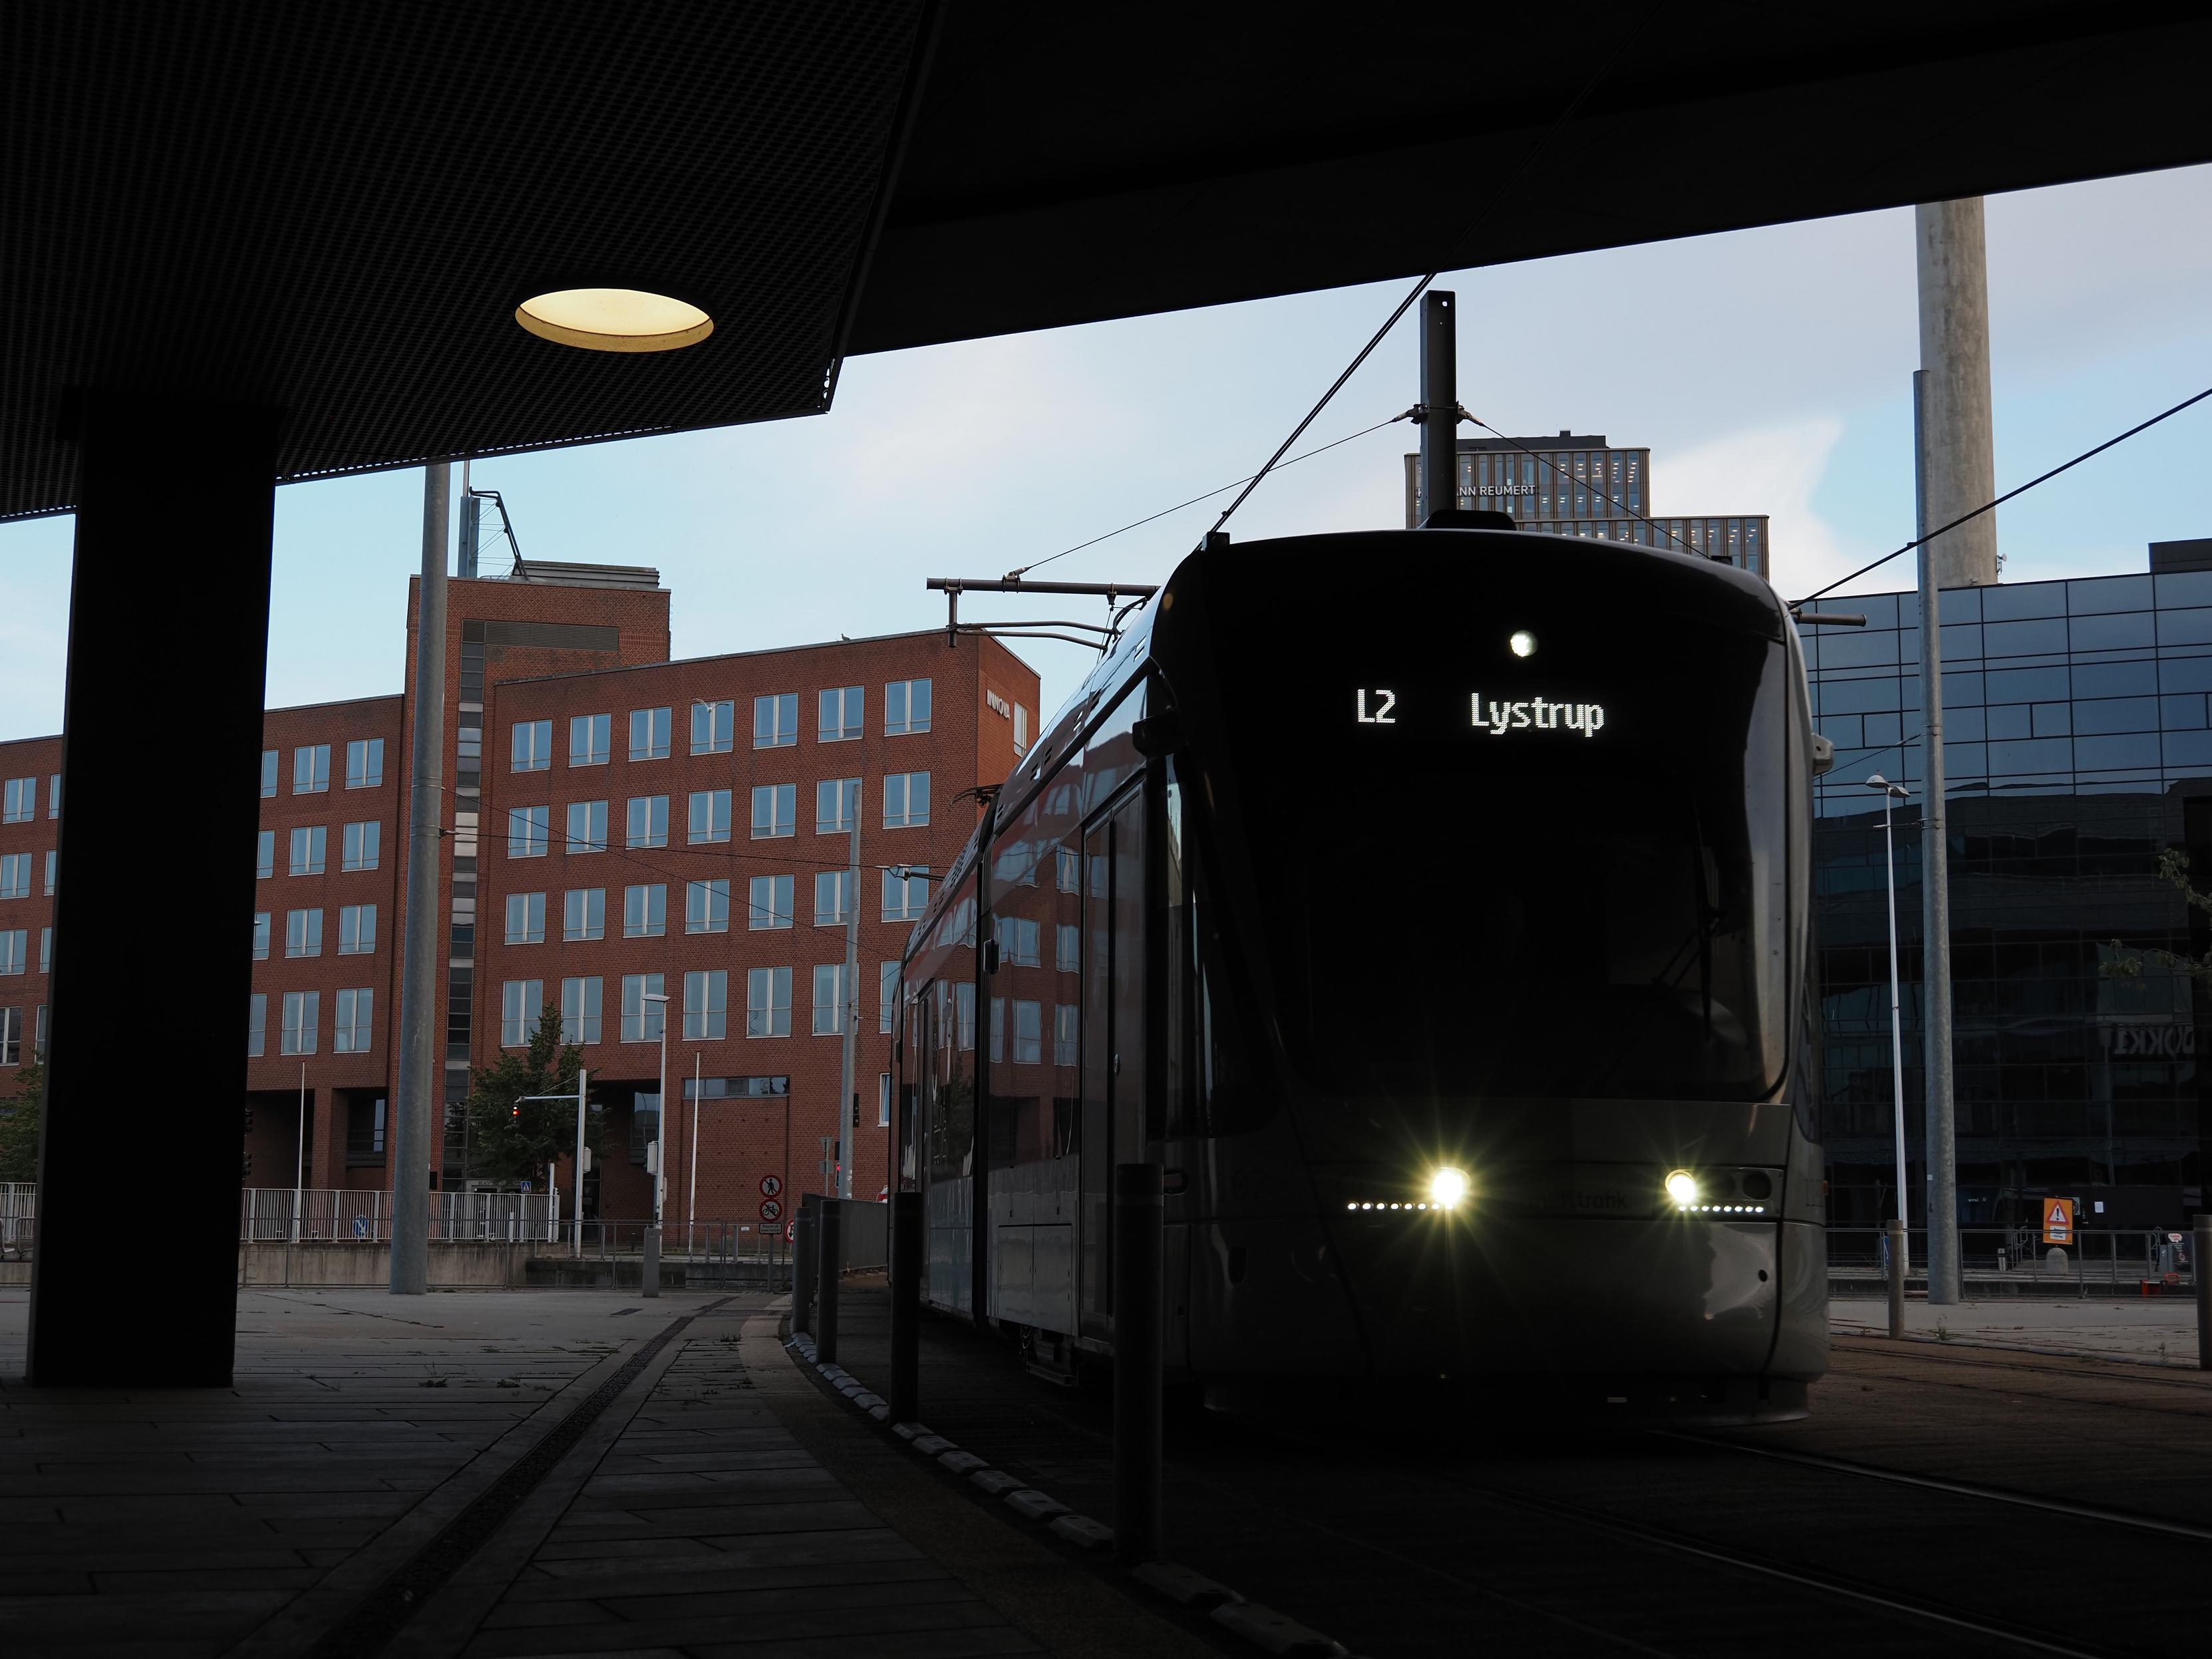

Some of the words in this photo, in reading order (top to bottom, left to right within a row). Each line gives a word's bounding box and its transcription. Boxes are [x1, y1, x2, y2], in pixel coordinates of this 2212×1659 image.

[1480, 485, 1535, 496] REUMERT
[987, 689, 1011, 720] INNOVA
[1357, 688, 1396, 724] L2
[1471, 692, 1604, 738] Lystrup
[1527, 1188, 1628, 1209] mdttrafik
